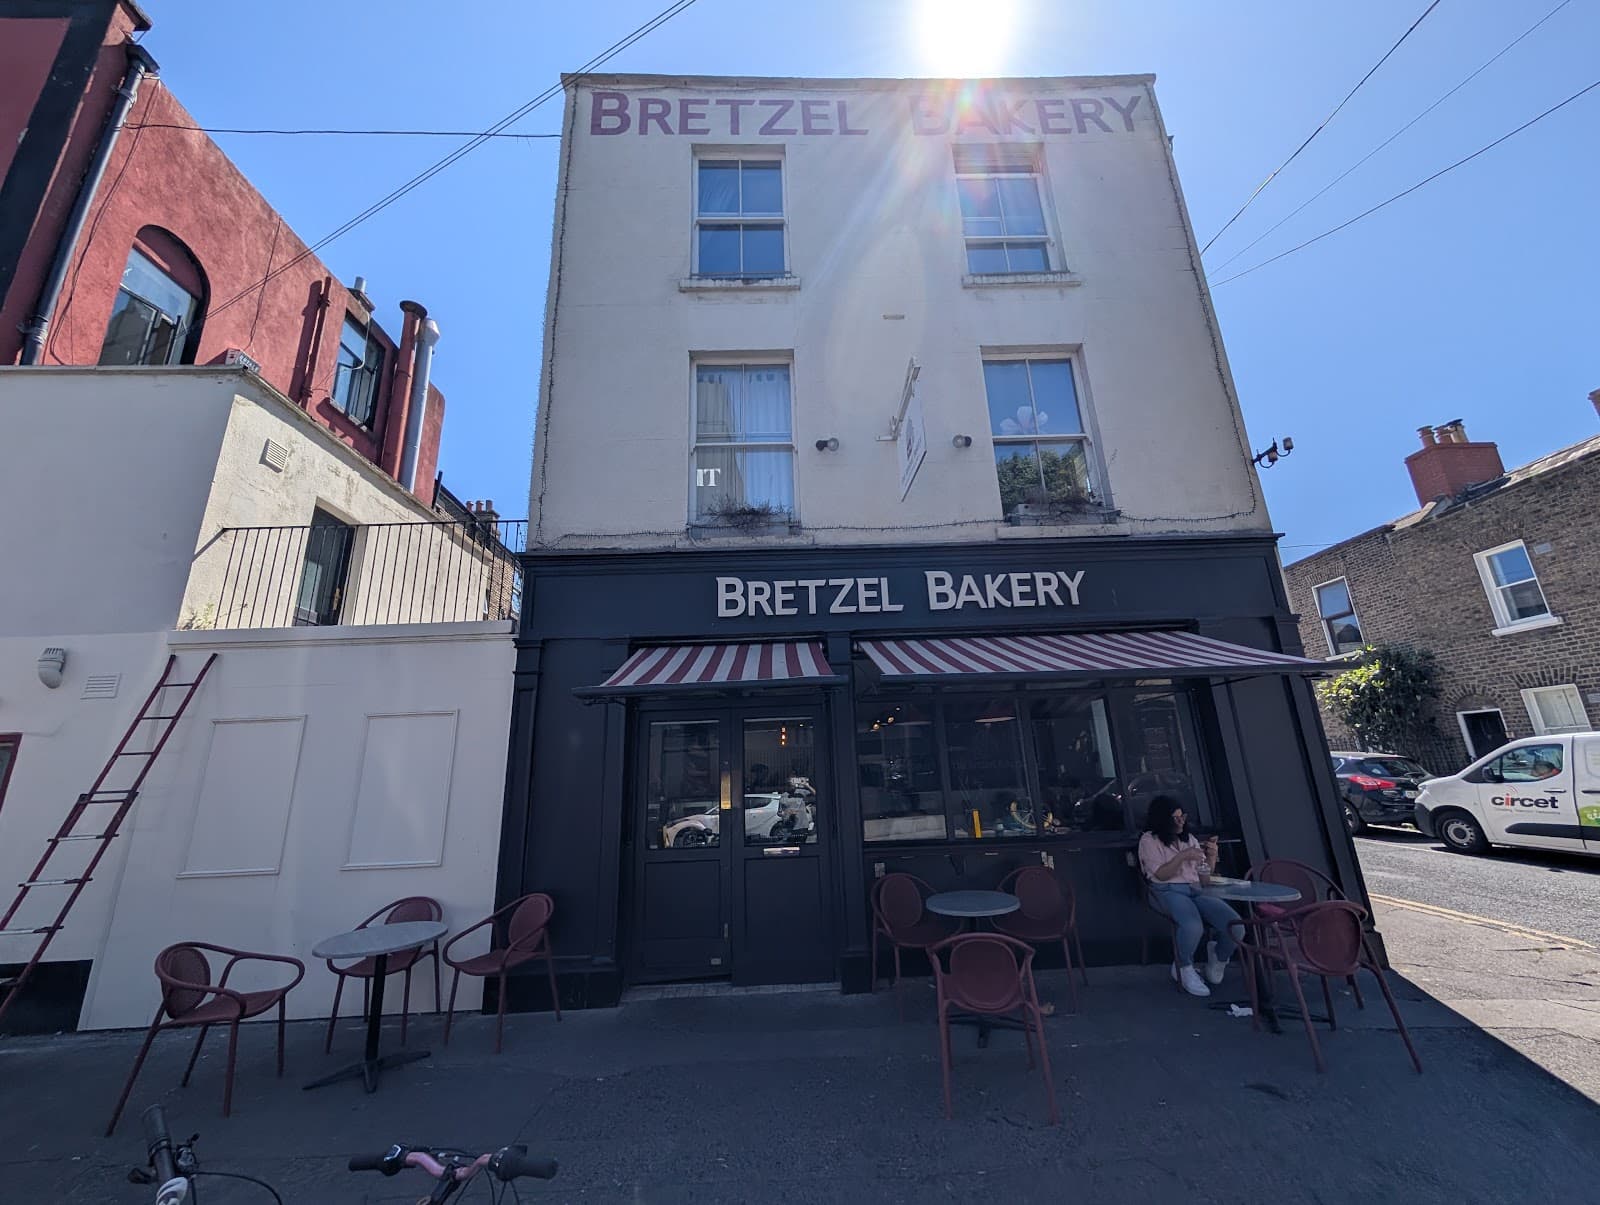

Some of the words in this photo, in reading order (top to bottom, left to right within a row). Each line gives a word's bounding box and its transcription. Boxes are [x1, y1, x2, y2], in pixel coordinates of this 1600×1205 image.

[590, 92, 869, 136] BRETZEL
[910, 95, 1141, 136] BAKERY
[716, 577, 904, 617] BRETZEL
[924, 570, 1085, 610] BAKERY
[1491, 793, 1558, 808] circet
